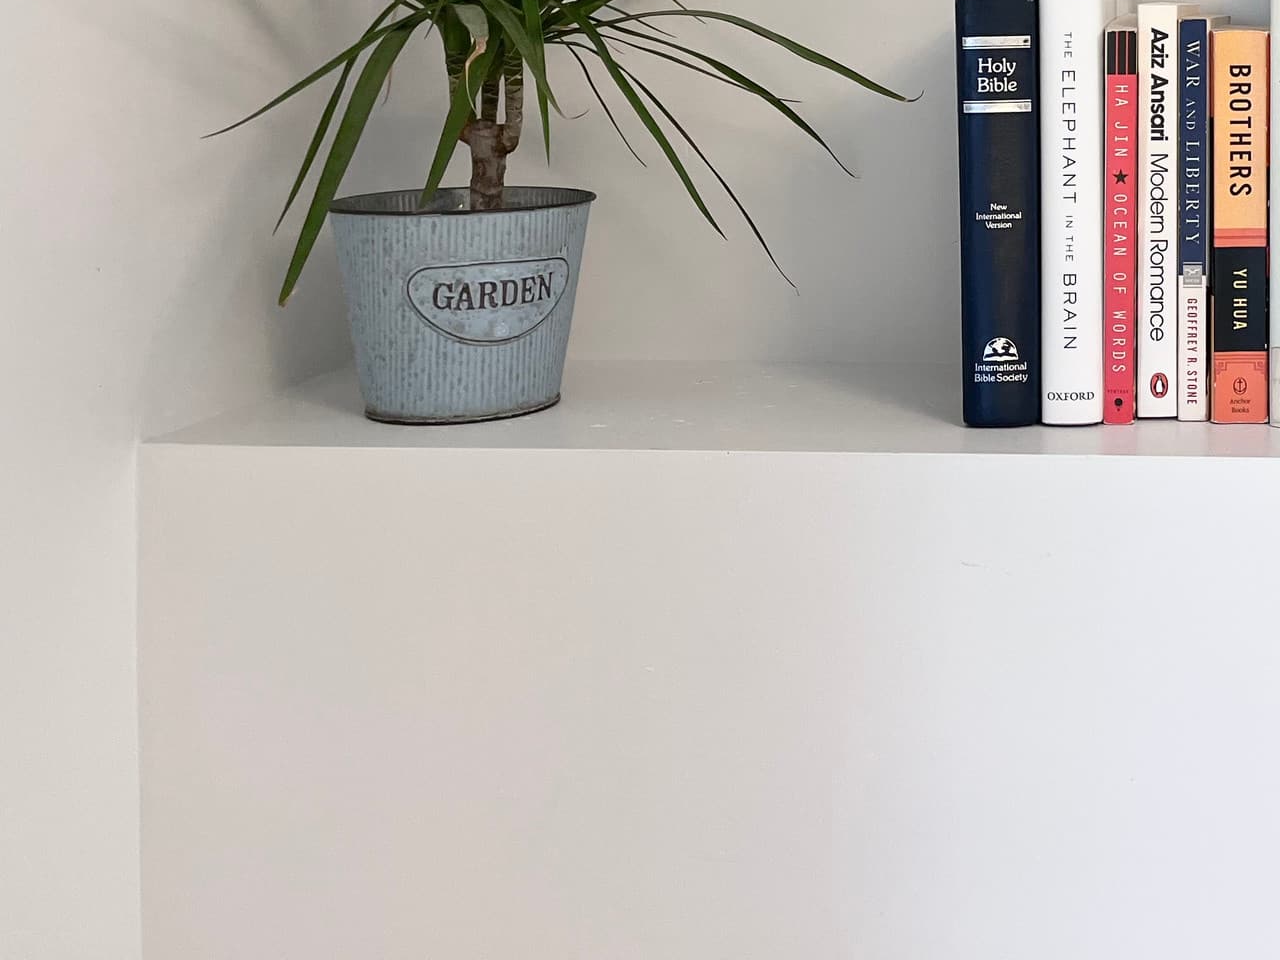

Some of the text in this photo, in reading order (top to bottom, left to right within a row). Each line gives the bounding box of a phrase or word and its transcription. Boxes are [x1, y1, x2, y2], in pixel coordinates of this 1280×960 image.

[977, 77, 1018, 92] Bible
[978, 58, 1016, 76] Holy
[1150, 28, 1169, 141] Aziz Ansari
[1114, 85, 1129, 157] HA JIN
[1229, 65, 1252, 196] BROTHERS
[1185, 40, 1200, 244] WAR AND LIBERTY
[990, 202, 1008, 210] New
[1062, 32, 1078, 350] THE ELEPHANT IN THE BRAIN
[976, 211, 1022, 220] International
[985, 221, 1012, 229] Version
[1113, 194, 1128, 256] OCEAN
[1150, 153, 1169, 342] Modern Romance
[432, 272, 554, 310] GARDEN
[1113, 272, 1127, 295] OF
[1233, 268, 1248, 330] YU HUA
[1112, 310, 1127, 373] WORDS
[1186, 298, 1198, 352] GEOFFREY
[974, 361, 1028, 372] International
[974, 373, 1028, 382] Bible Society
[1047, 392, 1095, 401] OXFORD
[1186, 370, 1198, 405] STONE
